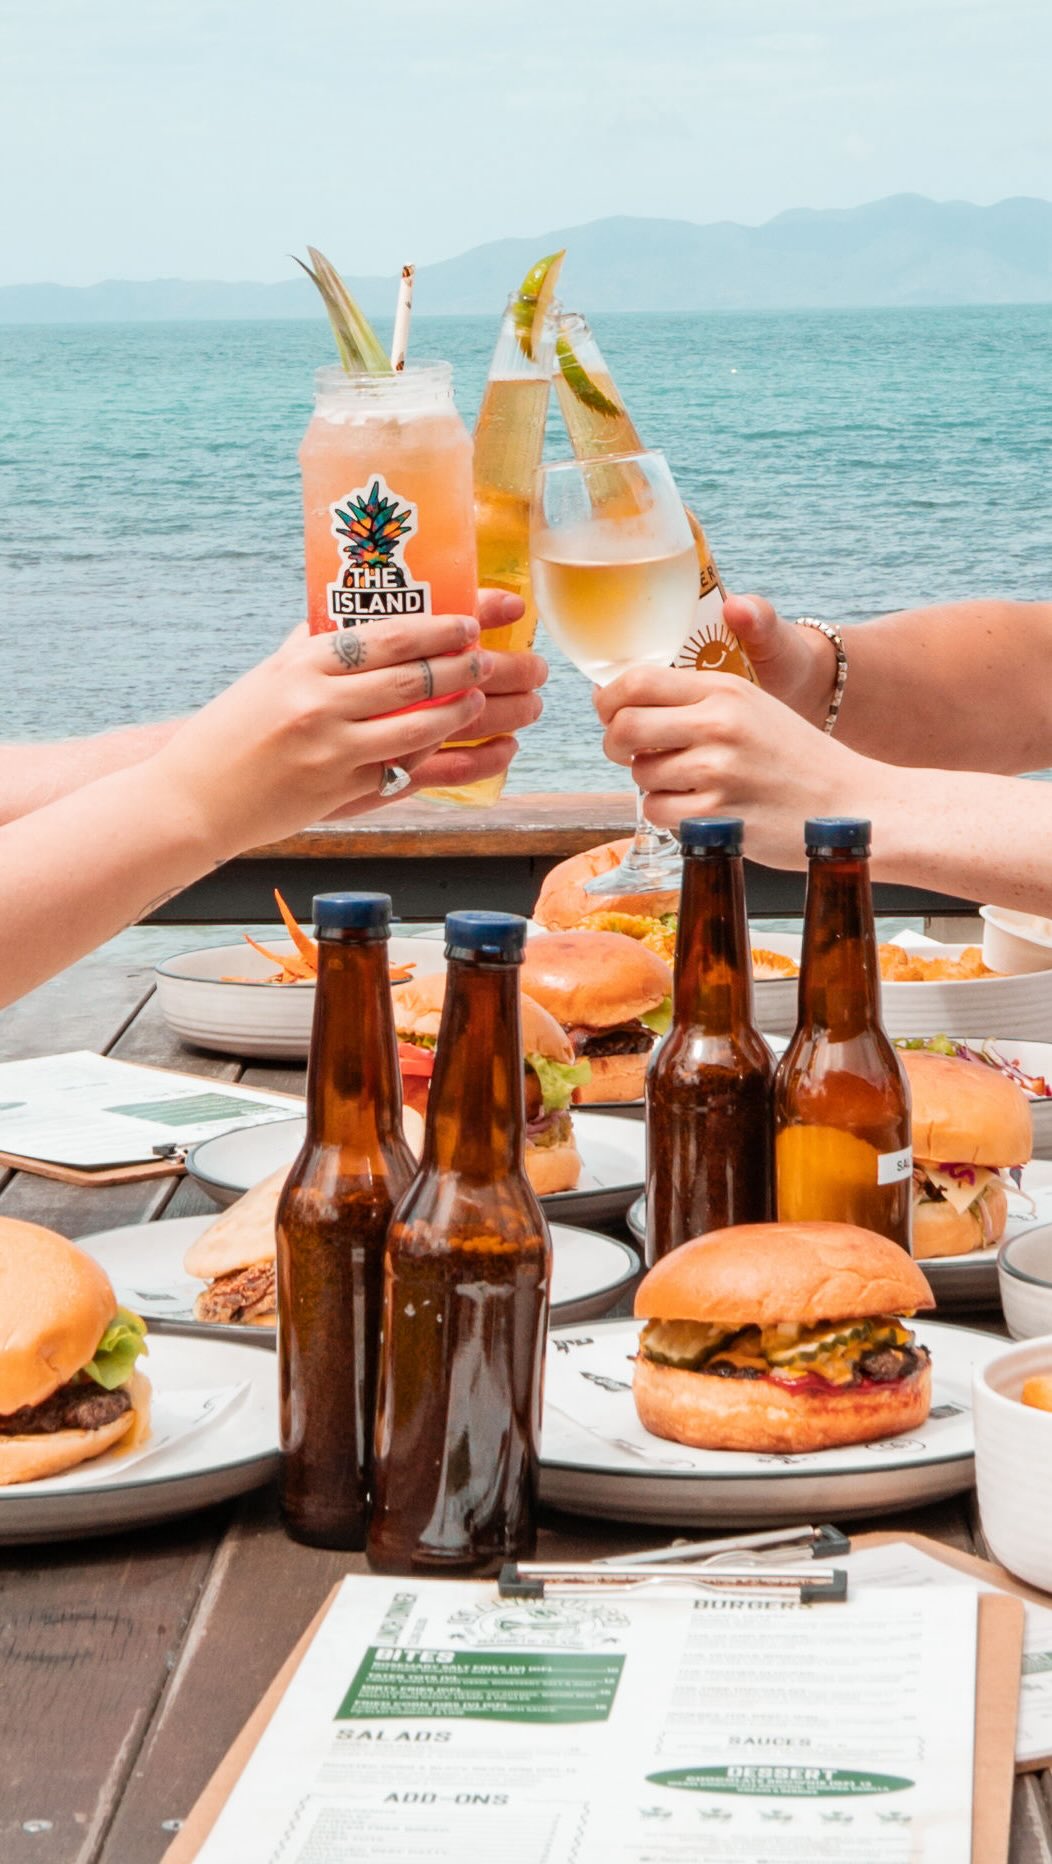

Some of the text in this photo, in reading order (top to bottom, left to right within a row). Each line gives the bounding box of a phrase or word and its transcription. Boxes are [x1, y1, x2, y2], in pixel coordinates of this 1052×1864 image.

[349, 567, 398, 589] THE
[335, 591, 421, 613] ISLAND
[375, 1648, 455, 1664] BITES
[335, 1728, 453, 1743] SALADS
[728, 1736, 812, 1747] SAUCES
[727, 1766, 838, 1780] DESSERT
[383, 1792, 511, 1806] ADD-ONS
